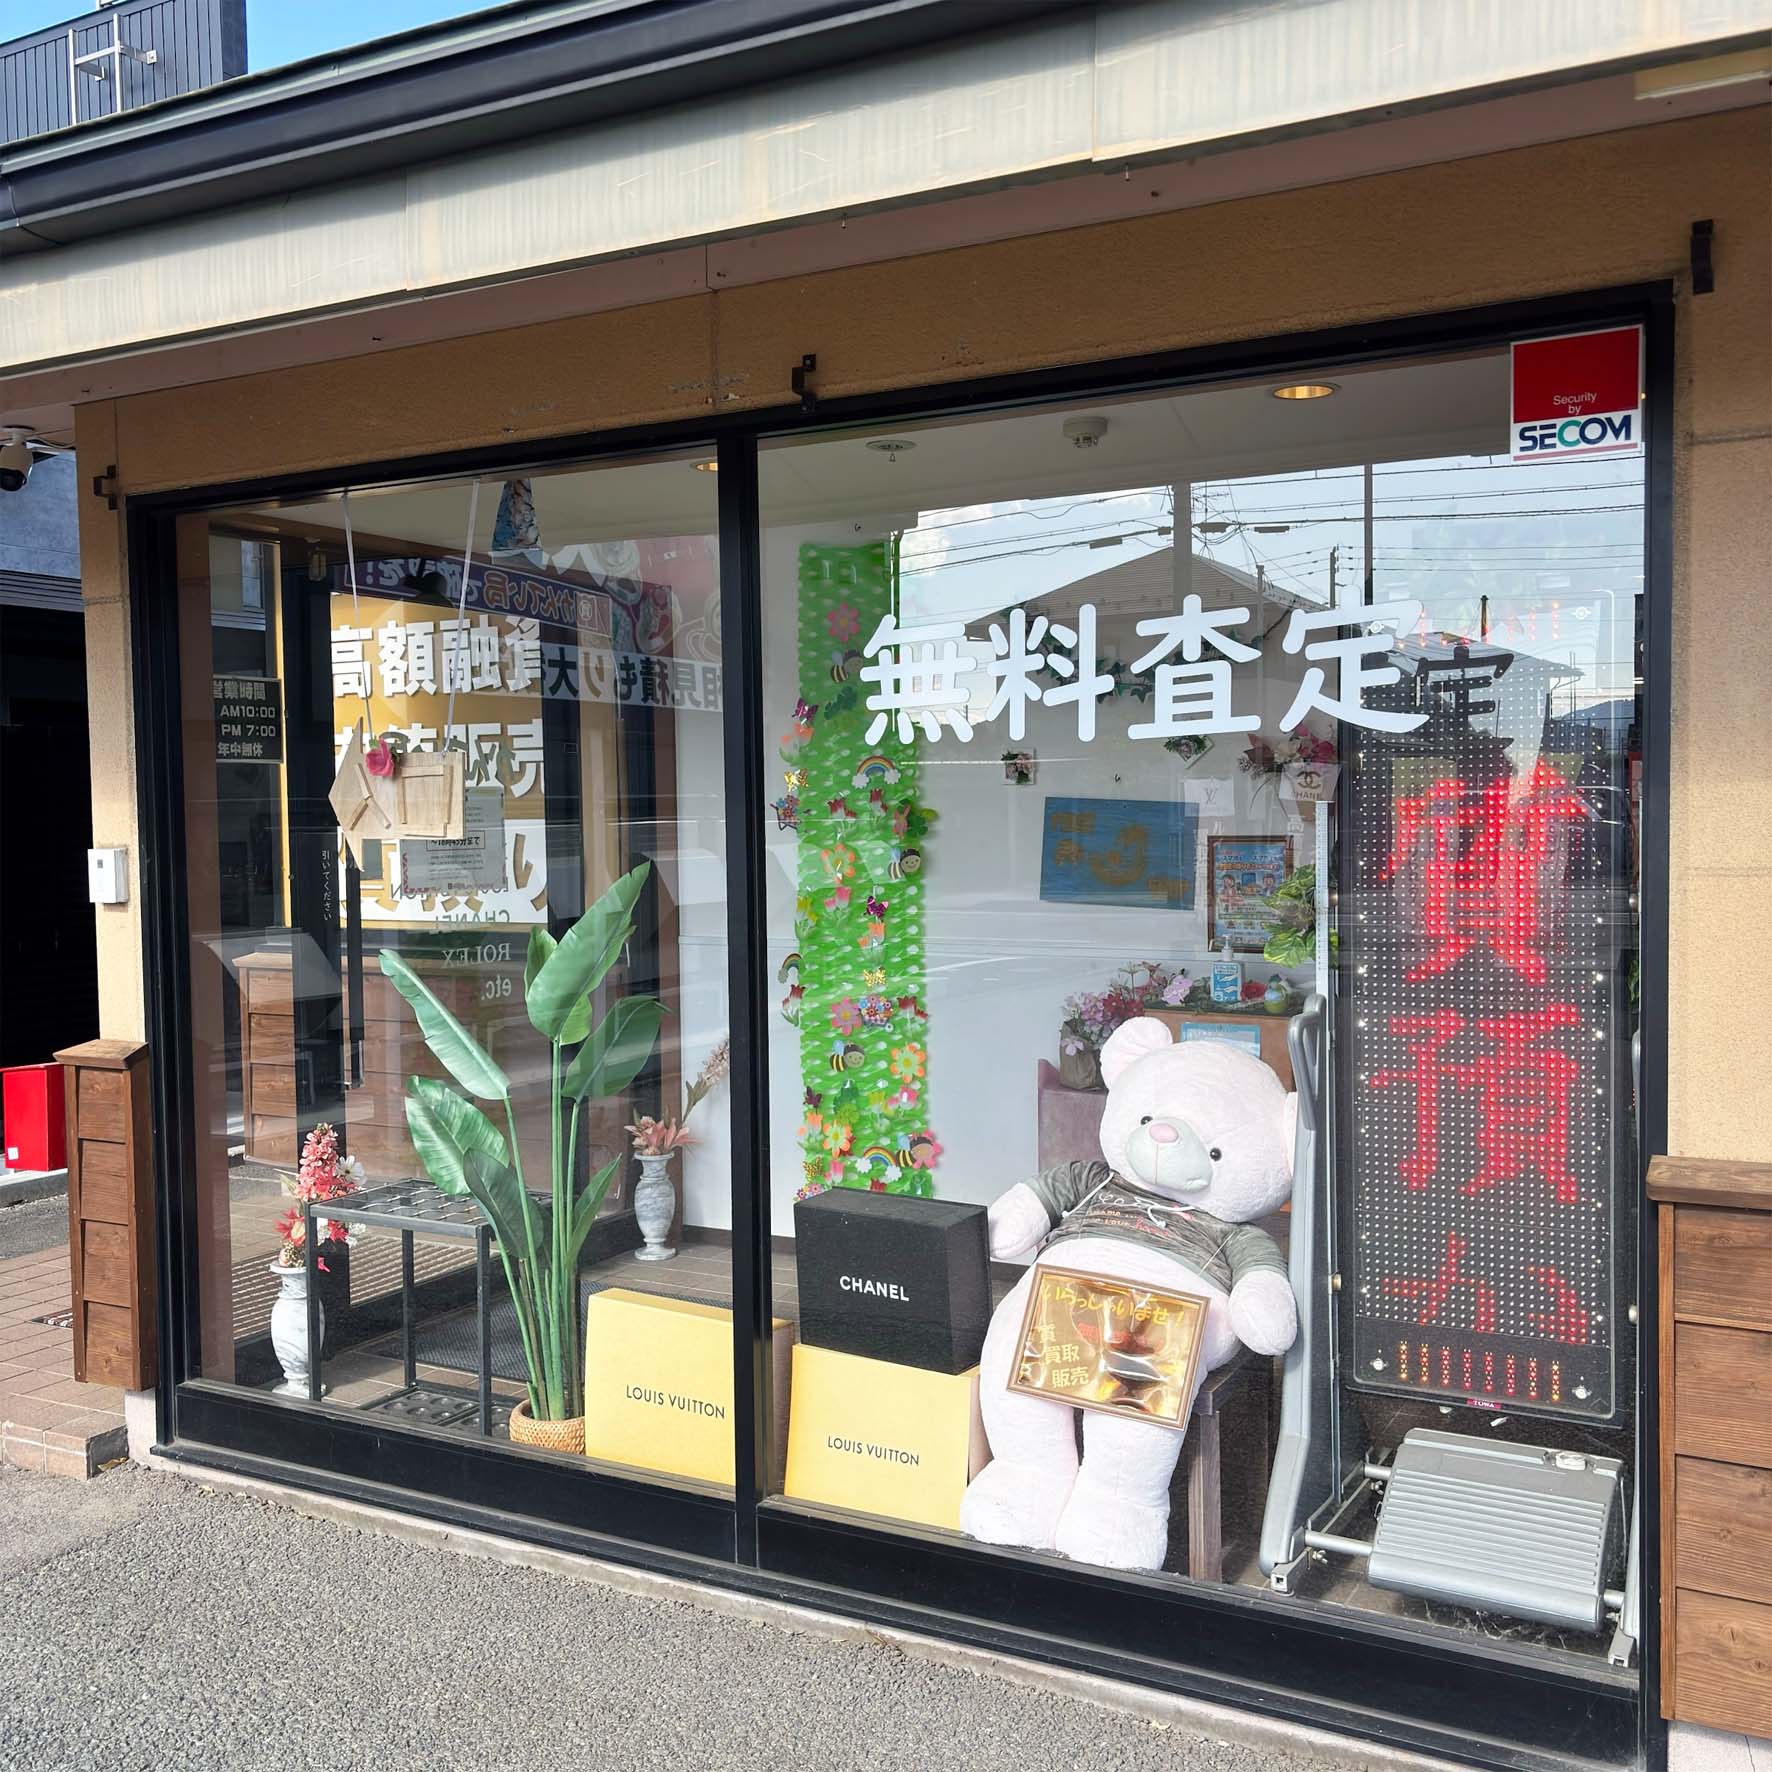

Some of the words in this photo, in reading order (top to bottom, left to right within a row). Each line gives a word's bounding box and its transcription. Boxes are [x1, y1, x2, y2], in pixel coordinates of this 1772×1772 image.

[1553, 391, 1597, 406] Security
[1568, 404, 1581, 415] by
[1519, 414, 1632, 452] SECOM
[860, 594, 1430, 745] 無料査定
[213, 680, 266, 700] 営業時間
[221, 724, 242, 737] PM
[246, 724, 276, 737] 7:00
[217, 741, 263, 757] 年中無休
[321, 849, 332, 921] 引いてください
[839, 1275, 910, 1302] CHANEL
[1045, 1343, 1081, 1365] 買取
[1051, 1366, 1089, 1389] 販売
[626, 1384, 664, 1406] LOUIS
[668, 1393, 725, 1420] VUITTON
[827, 1436, 863, 1455] LOUIS
[866, 1443, 920, 1466] VUITTON
